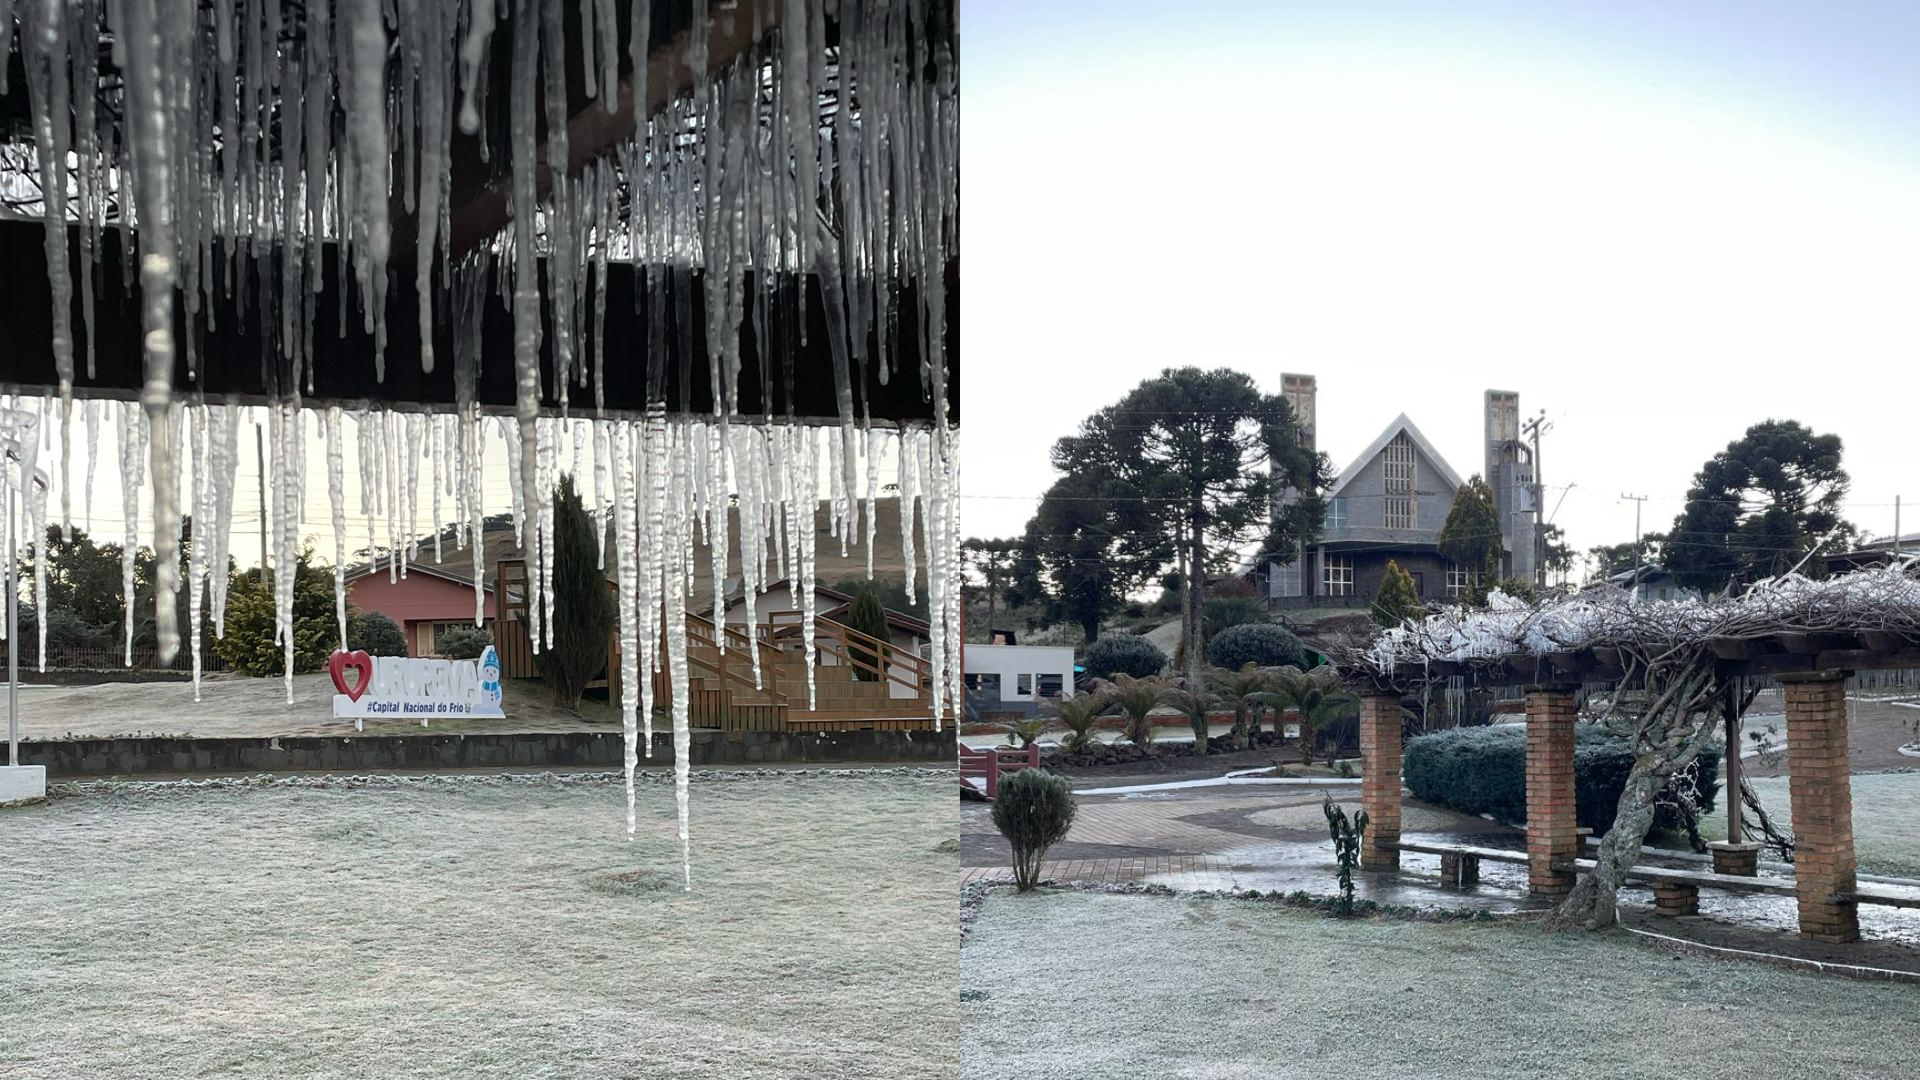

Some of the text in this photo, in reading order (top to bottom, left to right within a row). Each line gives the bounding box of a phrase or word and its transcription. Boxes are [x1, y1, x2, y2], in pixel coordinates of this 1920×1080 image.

[367, 701, 464, 714] #Capital Nacional do Frio
